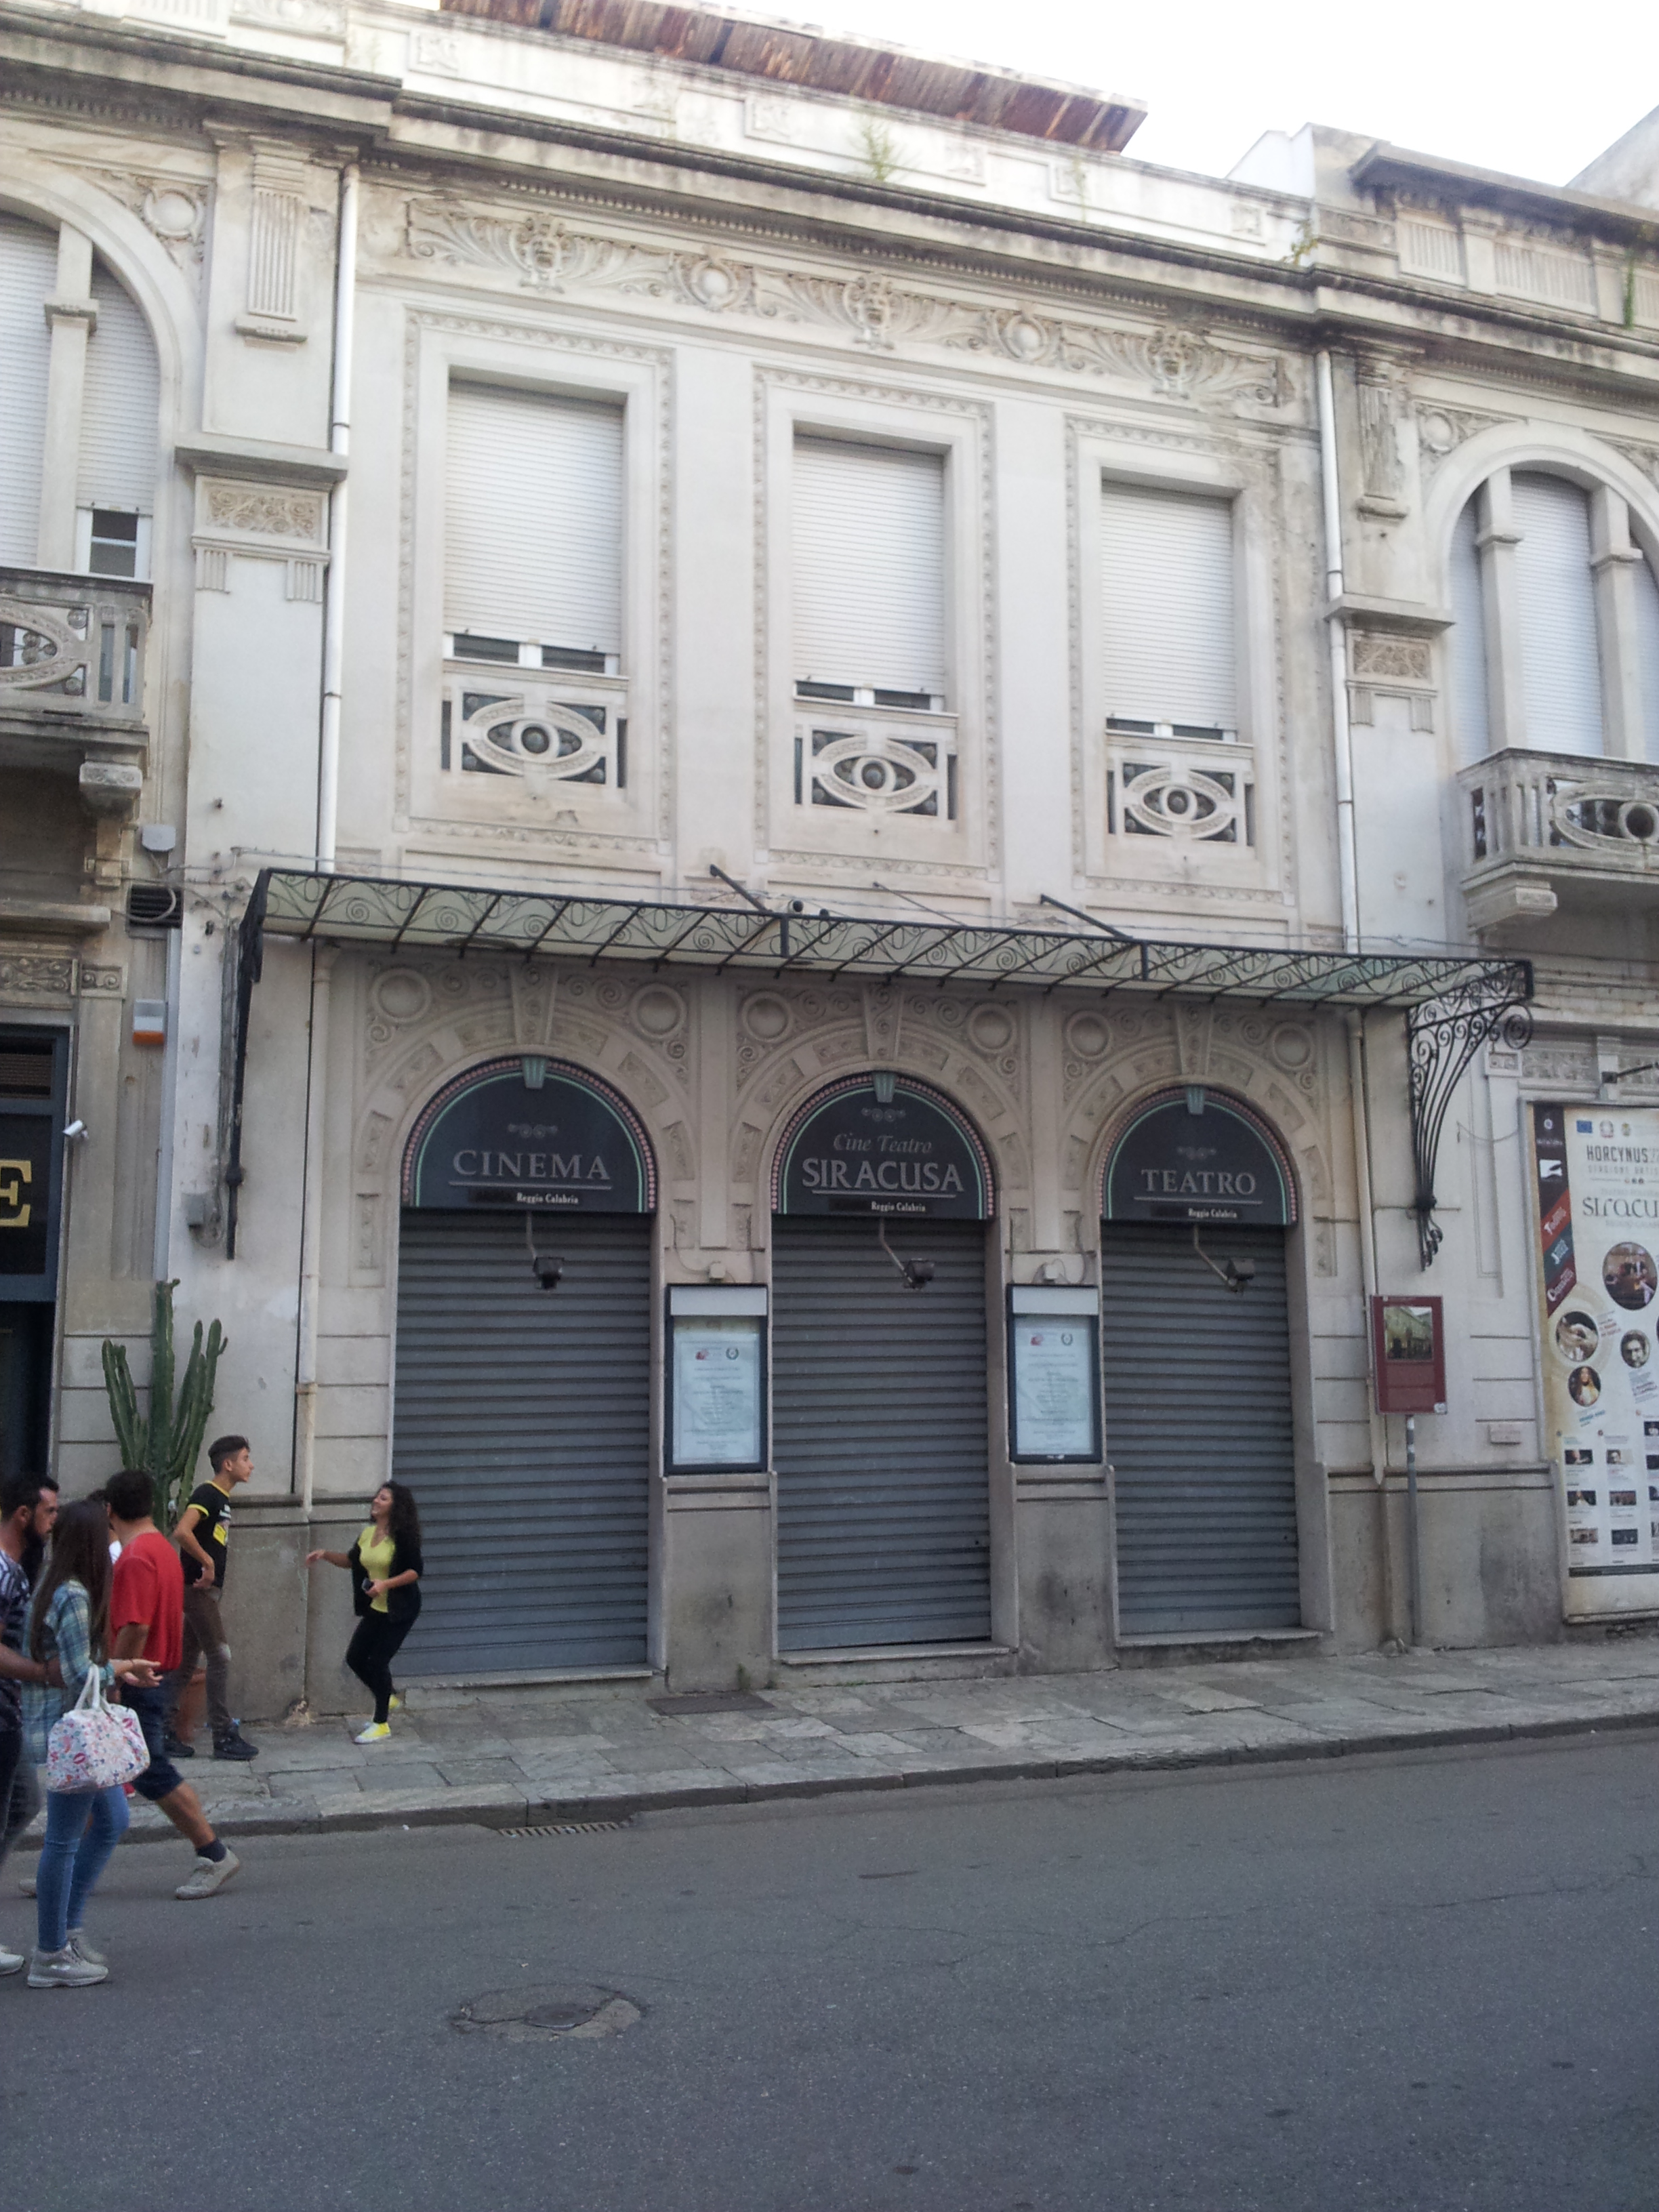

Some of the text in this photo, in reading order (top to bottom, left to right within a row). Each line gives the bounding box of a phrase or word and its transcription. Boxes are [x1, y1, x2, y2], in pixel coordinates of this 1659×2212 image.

[833, 1132, 933, 1153] Cine Teatro
[1586, 1144, 1648, 1163] HORCYNUS
[452, 1150, 611, 1181] CINEMA
[802, 1158, 964, 1192] SIRACUSA
[1141, 1169, 1256, 1195] TEATRO
[516, 1192, 579, 1204] Reggio Calabria
[872, 1201, 926, 1212] Reggio Calabria
[1188, 1208, 1238, 1218] Reggio Calabria
